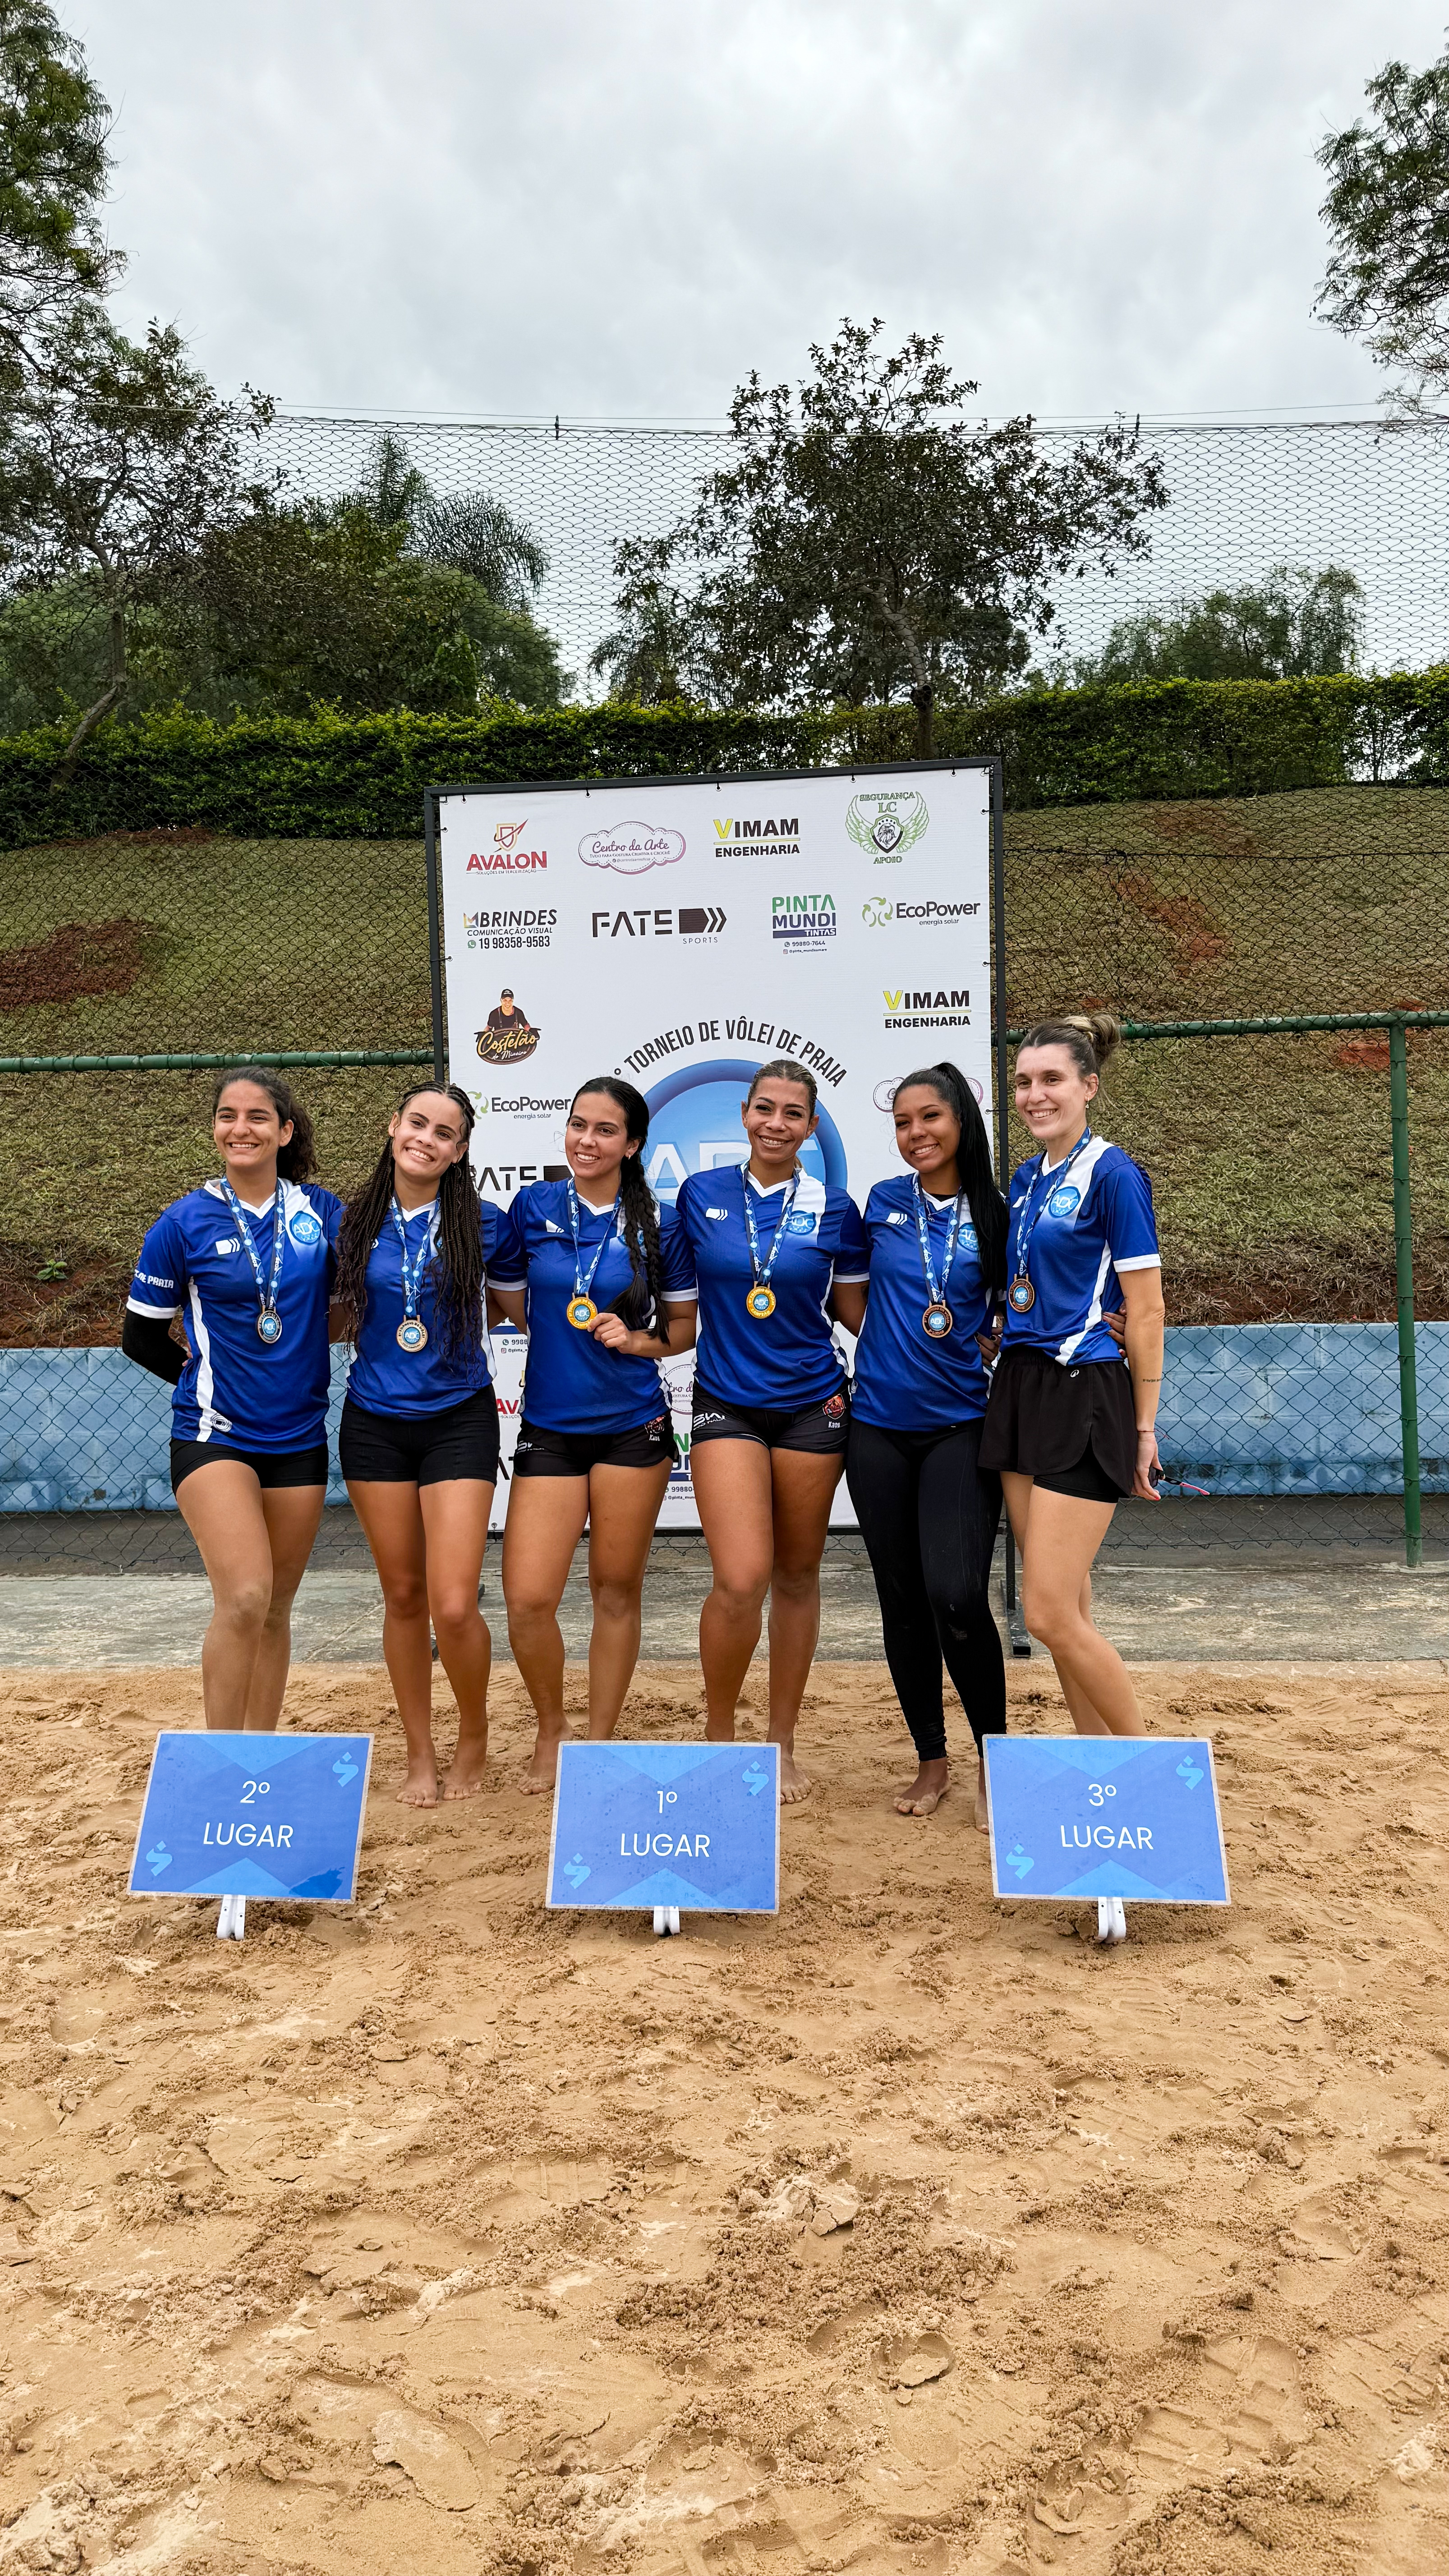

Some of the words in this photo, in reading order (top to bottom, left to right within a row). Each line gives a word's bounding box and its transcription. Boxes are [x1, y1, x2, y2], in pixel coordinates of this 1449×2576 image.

[860, 792, 915, 801] SEGURANÇA
[878, 801, 897, 813] LC
[713, 819, 799, 839] VIMAM
[593, 841, 627, 853] Centro
[629, 839, 642, 851] da
[644, 838, 669, 851] Arte
[716, 844, 800, 857] ENGENHARIA
[466, 851, 547, 871] AVALON
[773, 894, 836, 913] PINTA
[897, 902, 980, 918] EcoPower
[592, 910, 672, 937] FATE
[773, 912, 836, 929] MUNDI
[467, 927, 526, 936] COMUNICAÇÃO
[478, 938, 489, 949] 19
[492, 936, 550, 948] 98358-9583
[883, 990, 969, 1010] VIMAM
[885, 1016, 971, 1028] ENGENHARIA
[478, 1029, 538, 1055] Costelão
[624, 1026, 694, 1074] TORNEIO
[699, 1020, 721, 1042] DE
[726, 1016, 775, 1045] VÔLEI
[776, 1029, 802, 1054] DE
[799, 1041, 847, 1088] PRAIA
[492, 1096, 571, 1112] EcoPower
[1051, 1195, 1078, 1209] ADC
[294, 1220, 320, 1235] ADC
[147, 1275, 174, 1288] PRAIA
[240, 1780, 270, 1803] 2º
[1088, 1783, 1117, 1806] 3º
[657, 1790, 677, 1813] 1º
[203, 1822, 293, 1848] LUGAR
[1061, 1825, 1154, 1849] LUGAR
[621, 1833, 710, 1857] LUGAR
